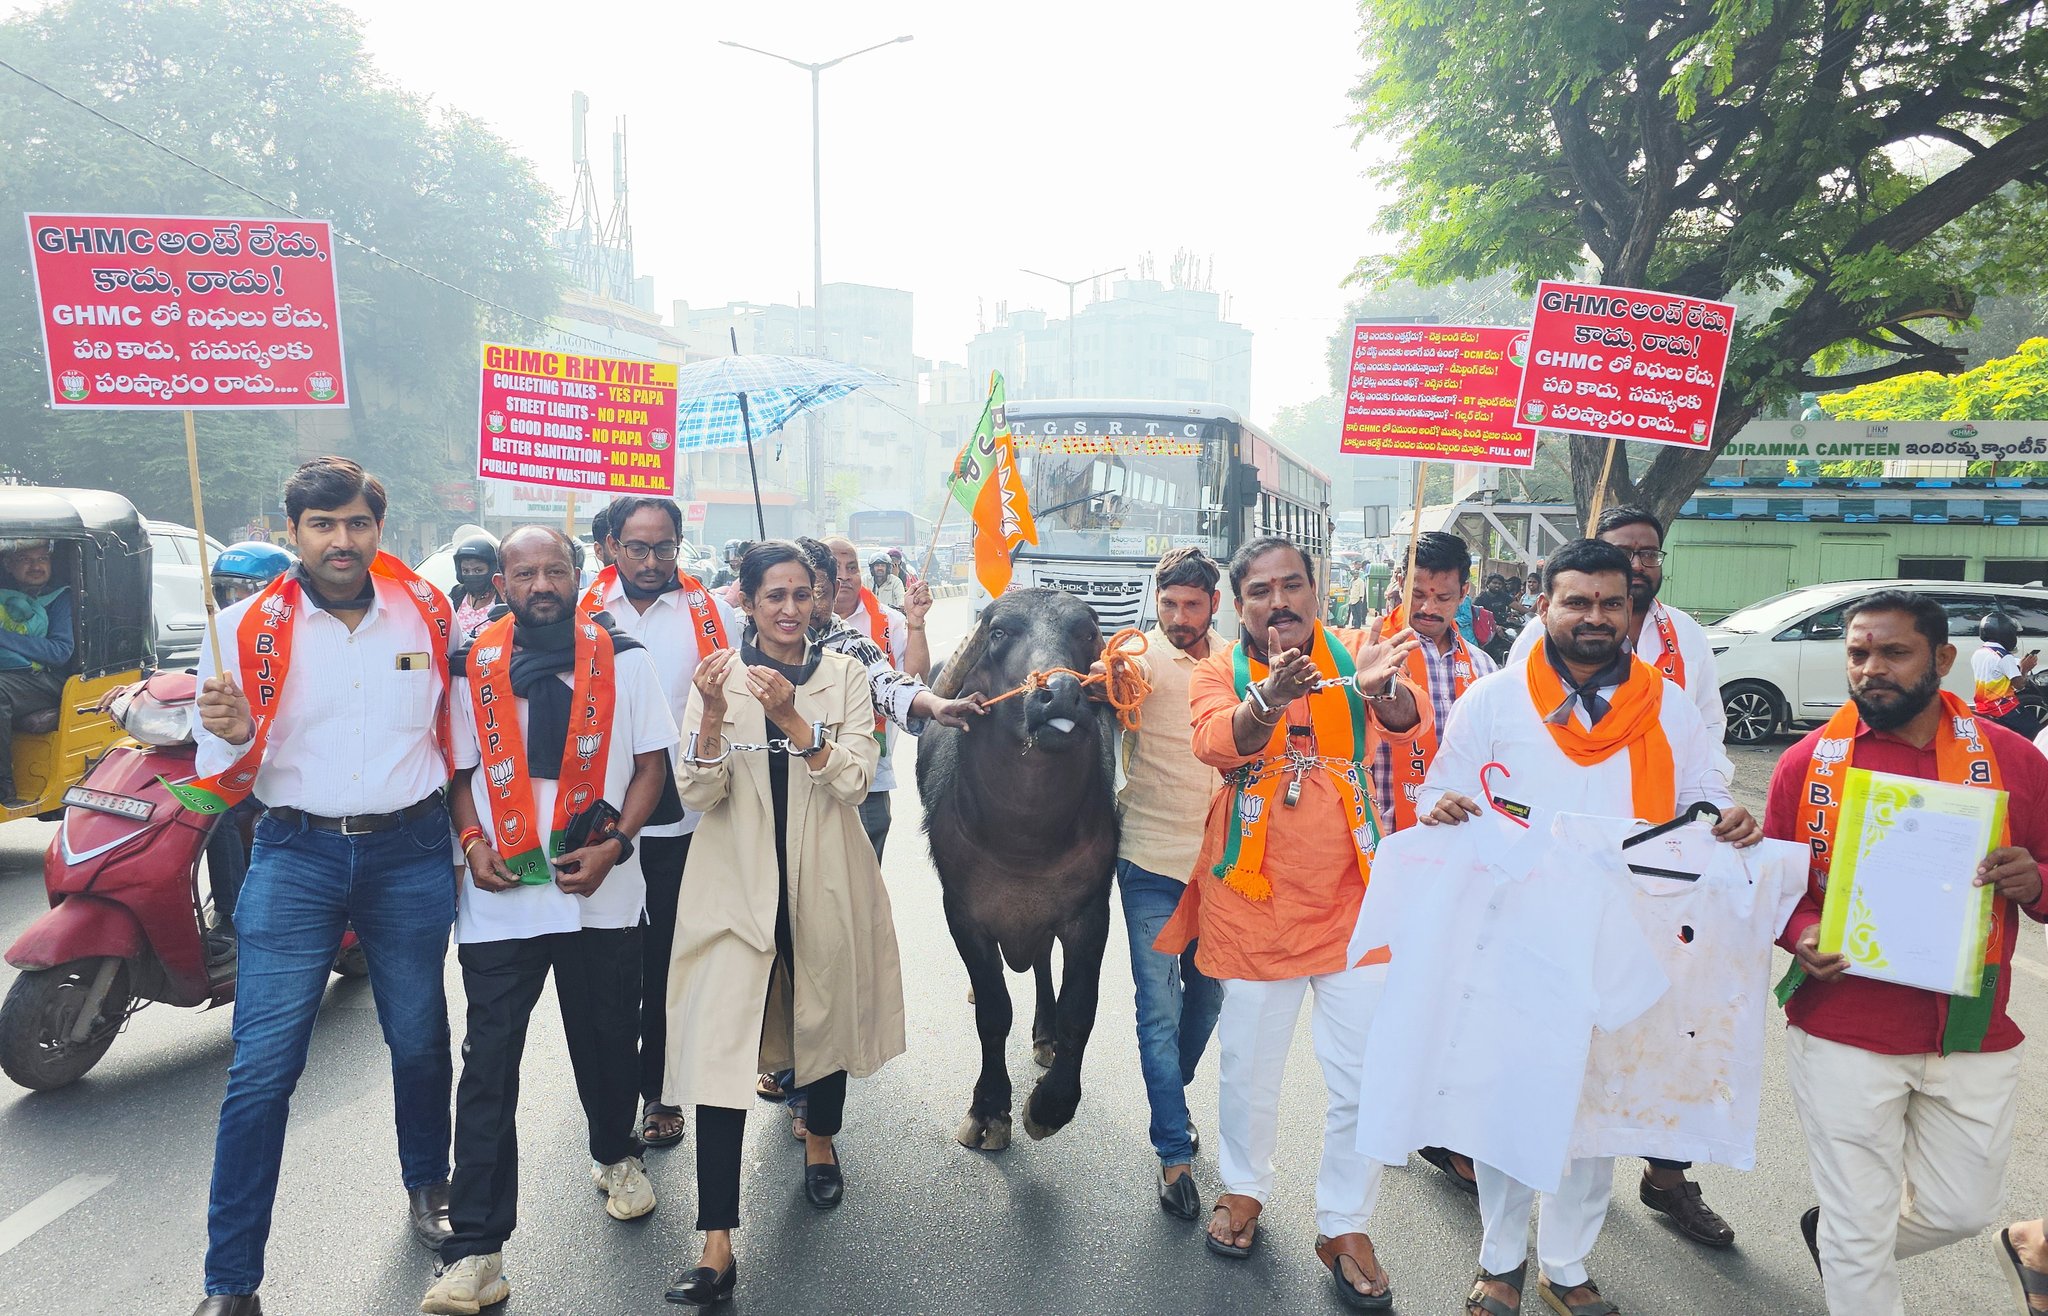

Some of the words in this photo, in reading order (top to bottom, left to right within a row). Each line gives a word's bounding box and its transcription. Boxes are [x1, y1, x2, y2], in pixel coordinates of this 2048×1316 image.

[38, 228, 153, 254] GHMC
[158, 224, 241, 257] అంటే
[249, 225, 327, 262] లేదు,
[91, 267, 182, 296] కాదు,
[186, 266, 285, 296] రాదు!
[53, 304, 142, 326] GHMC
[151, 302, 181, 326] లో
[186, 307, 266, 331] నిధులు
[272, 304, 329, 329] లేదు,
[1542, 292, 1629, 318] GHMC
[1630, 301, 1686, 325] అంటే
[1687, 305, 1728, 335] లేదు,
[72, 339, 112, 360] పని
[116, 341, 180, 361] కాదు,
[189, 340, 314, 369] సమస్యలకు
[1575, 325, 1636, 352] కాదు,
[1641, 333, 1701, 358] రాదు!
[486, 346, 559, 376] GHMC
[565, 356, 674, 387] RHYME...
[1535, 350, 1603, 370] GHMC
[1608, 356, 1632, 373] లో
[1634, 362, 1683, 380] నిధులు
[1685, 365, 1715, 388] లేదు,
[95, 374, 209, 400] పరిష్కారం
[493, 373, 559, 395] COLLECTING
[561, 382, 596, 399] TAXES
[609, 387, 631, 402] YES
[633, 389, 664, 405] PAPA
[1464, 397, 1475, 405] BT
[1542, 377, 1573, 393] పని
[1576, 381, 1621, 401] కాదు,
[1629, 386, 1702, 413] సమస్యలకు
[506, 397, 546, 415] STREET
[548, 402, 588, 420] LIGHTS
[597, 408, 615, 423] NO
[618, 410, 648, 425] PAPA
[1551, 404, 1635, 429] పరిష్కారం
[510, 419, 541, 436] GOOD
[544, 423, 583, 441] ROADS
[592, 429, 609, 444] NO
[612, 431, 642, 446] PAPA
[1360, 425, 1380, 433] GHMC
[492, 437, 532, 455] BETTER
[534, 443, 601, 464] SANITATION
[611, 451, 627, 466] NO
[630, 454, 661, 468] PAPA
[1489, 447, 1512, 456] FULL
[1514, 448, 1531, 458] ON!
[1721, 443, 1809, 456] DIRAMMA
[1816, 443, 1900, 456] CANTEEN
[1906, 441, 1980, 460] ఇందిరమ్మ
[1981, 436, 2048, 461] క్యాంటీన్
[482, 458, 517, 475] PUBLIC
[519, 464, 553, 480] MONEY
[556, 468, 606, 486] WASTING
[1146, 535, 1170, 556] 8A
[1049, 582, 1082, 590] ASHOK
[1088, 583, 1136, 592] LEYLAND
